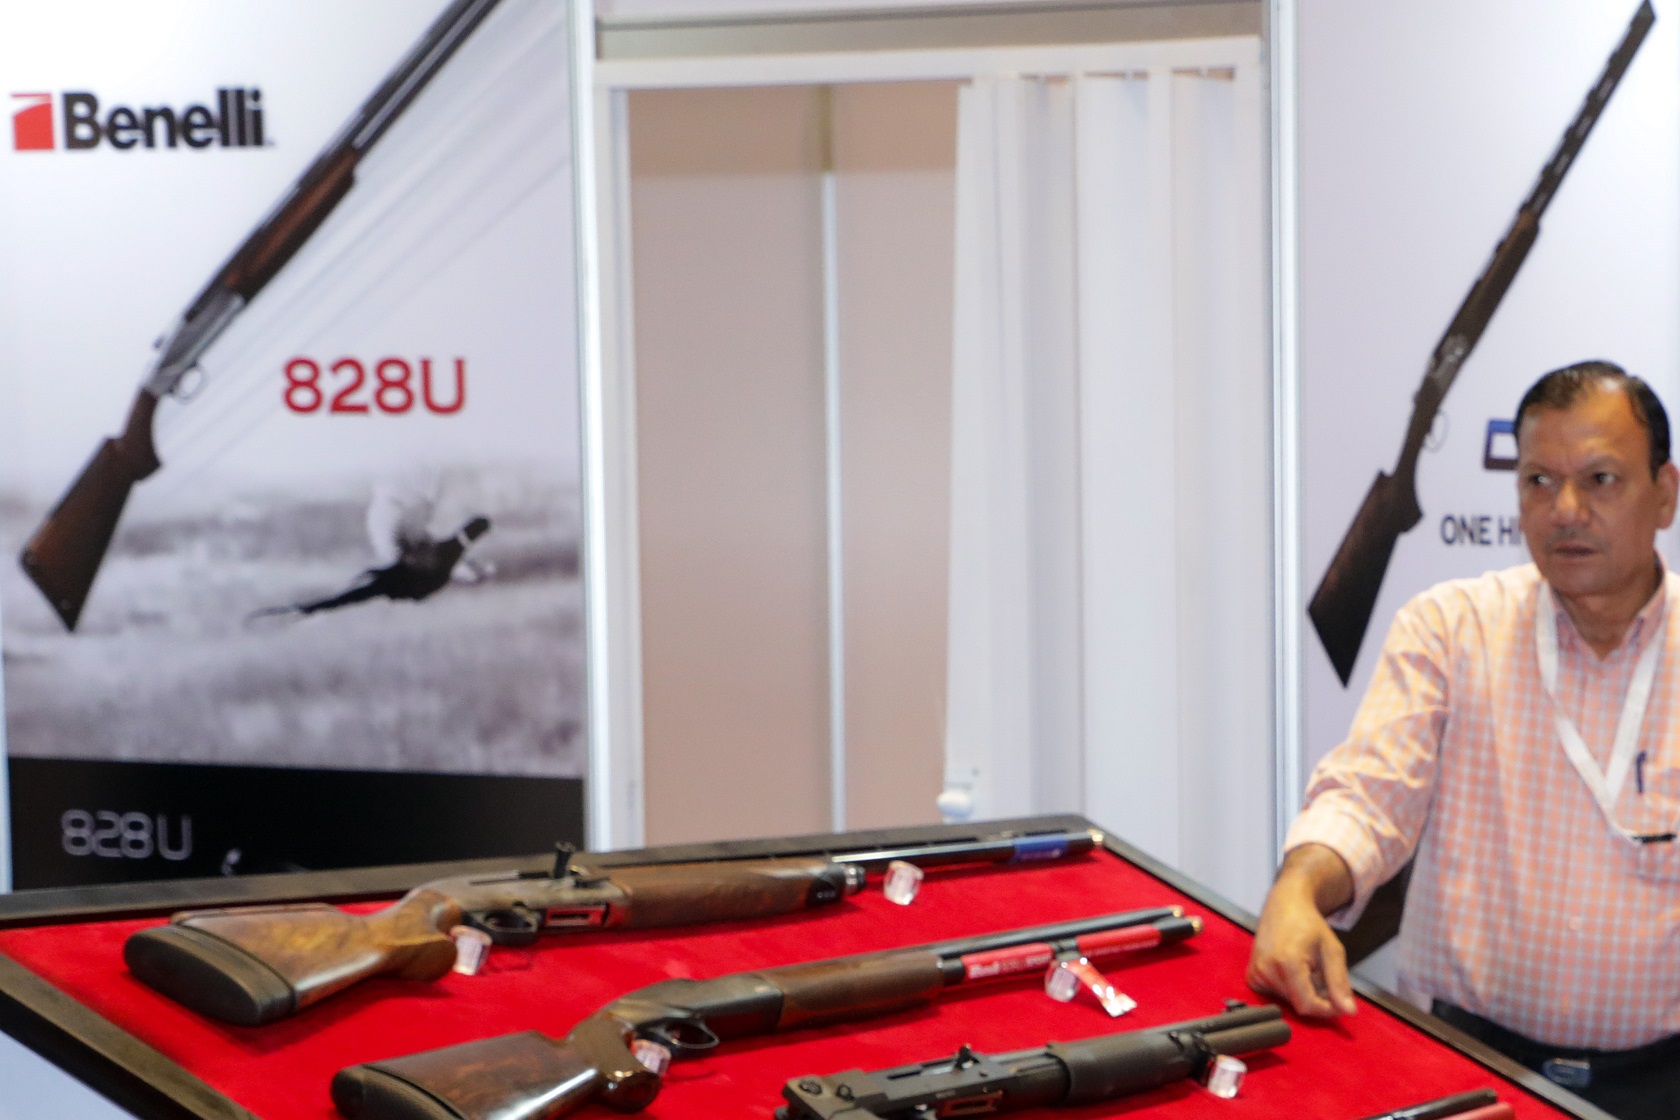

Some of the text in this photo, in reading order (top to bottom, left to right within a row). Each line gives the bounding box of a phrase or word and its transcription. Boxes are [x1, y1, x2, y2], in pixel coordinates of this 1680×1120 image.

[61, 86, 265, 150] Benelli
[283, 356, 467, 415] 828U
[1441, 513, 1492, 546] ONE
[61, 809, 193, 861] 828U
